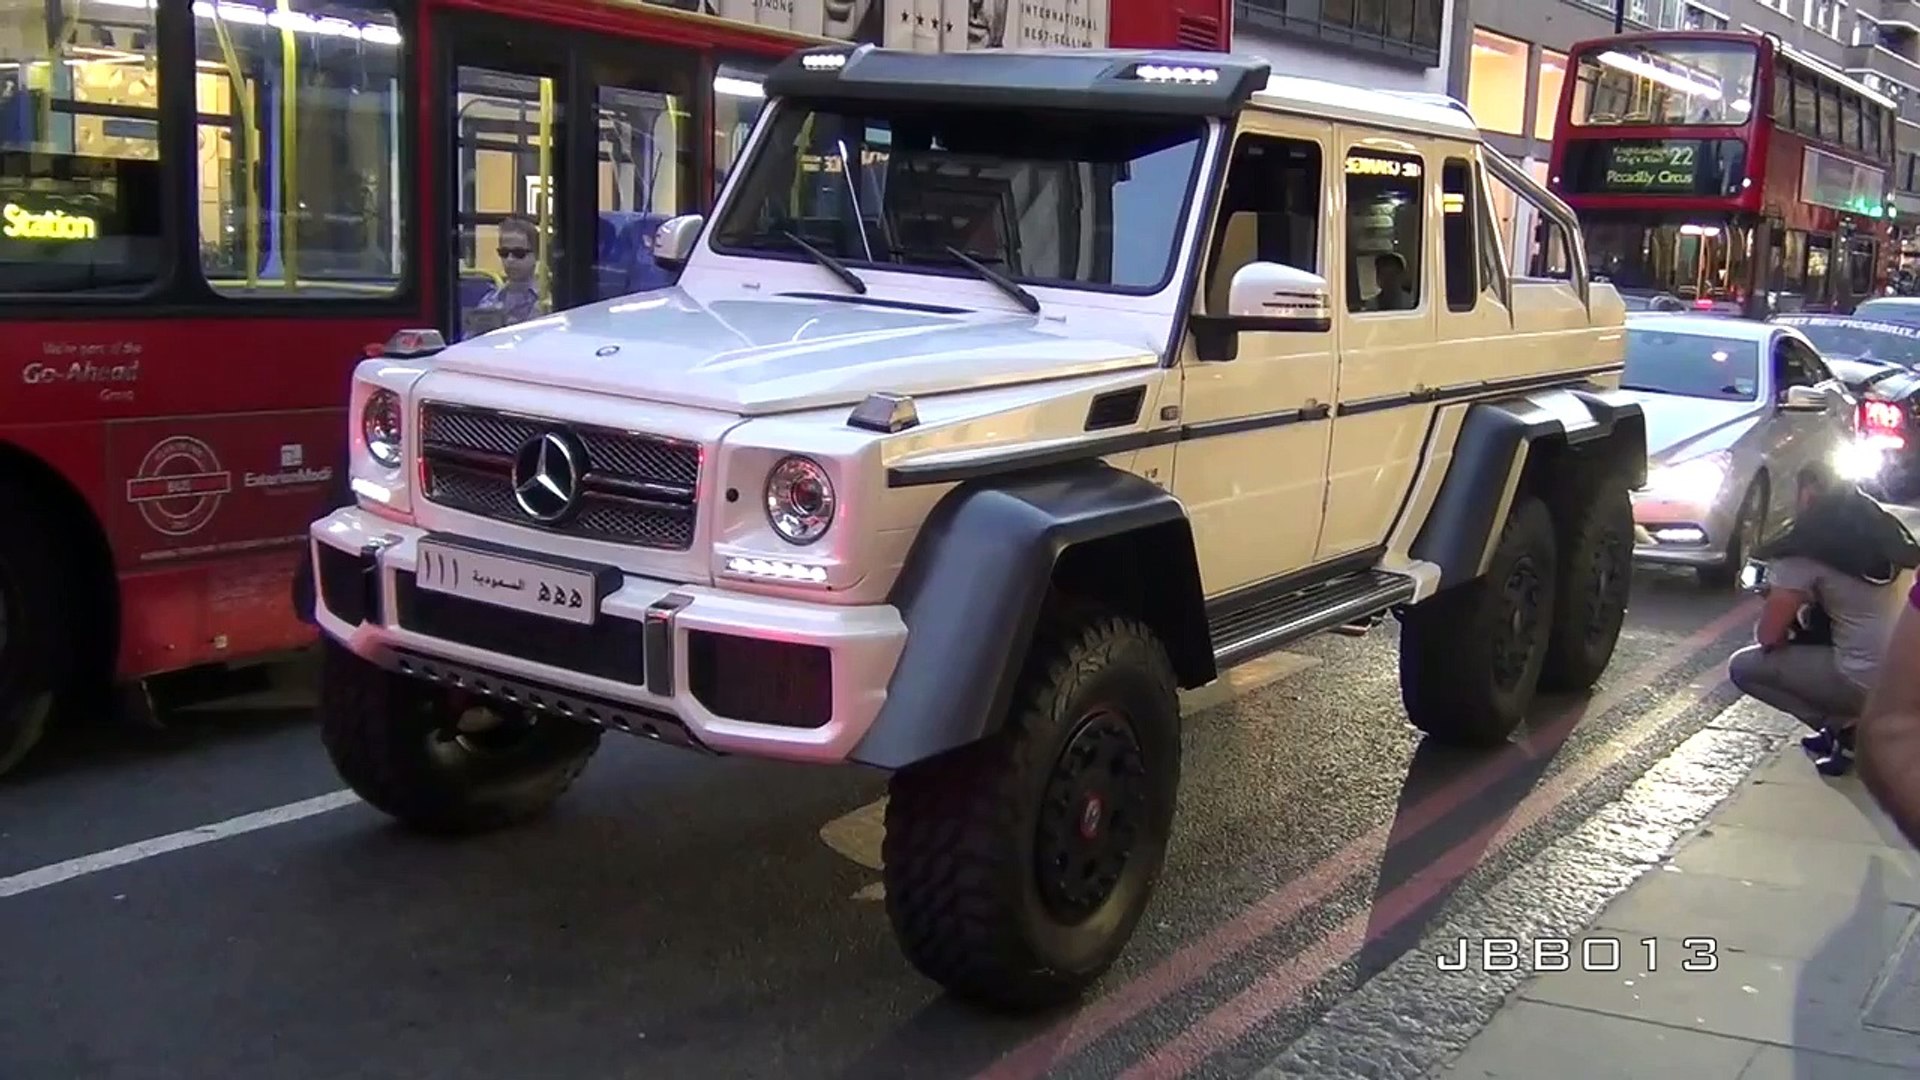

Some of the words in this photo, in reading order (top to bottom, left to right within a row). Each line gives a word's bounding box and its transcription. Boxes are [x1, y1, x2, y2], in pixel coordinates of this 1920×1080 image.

[1020, 2, 1097, 31] INTERNATIONAL
[1669, 145, 1694, 165] 22
[1606, 169, 1656, 187] Piccadilly
[1658, 170, 1693, 183] Circus
[3, 203, 95, 239] Station
[23, 360, 140, 384] Go-Ahead
